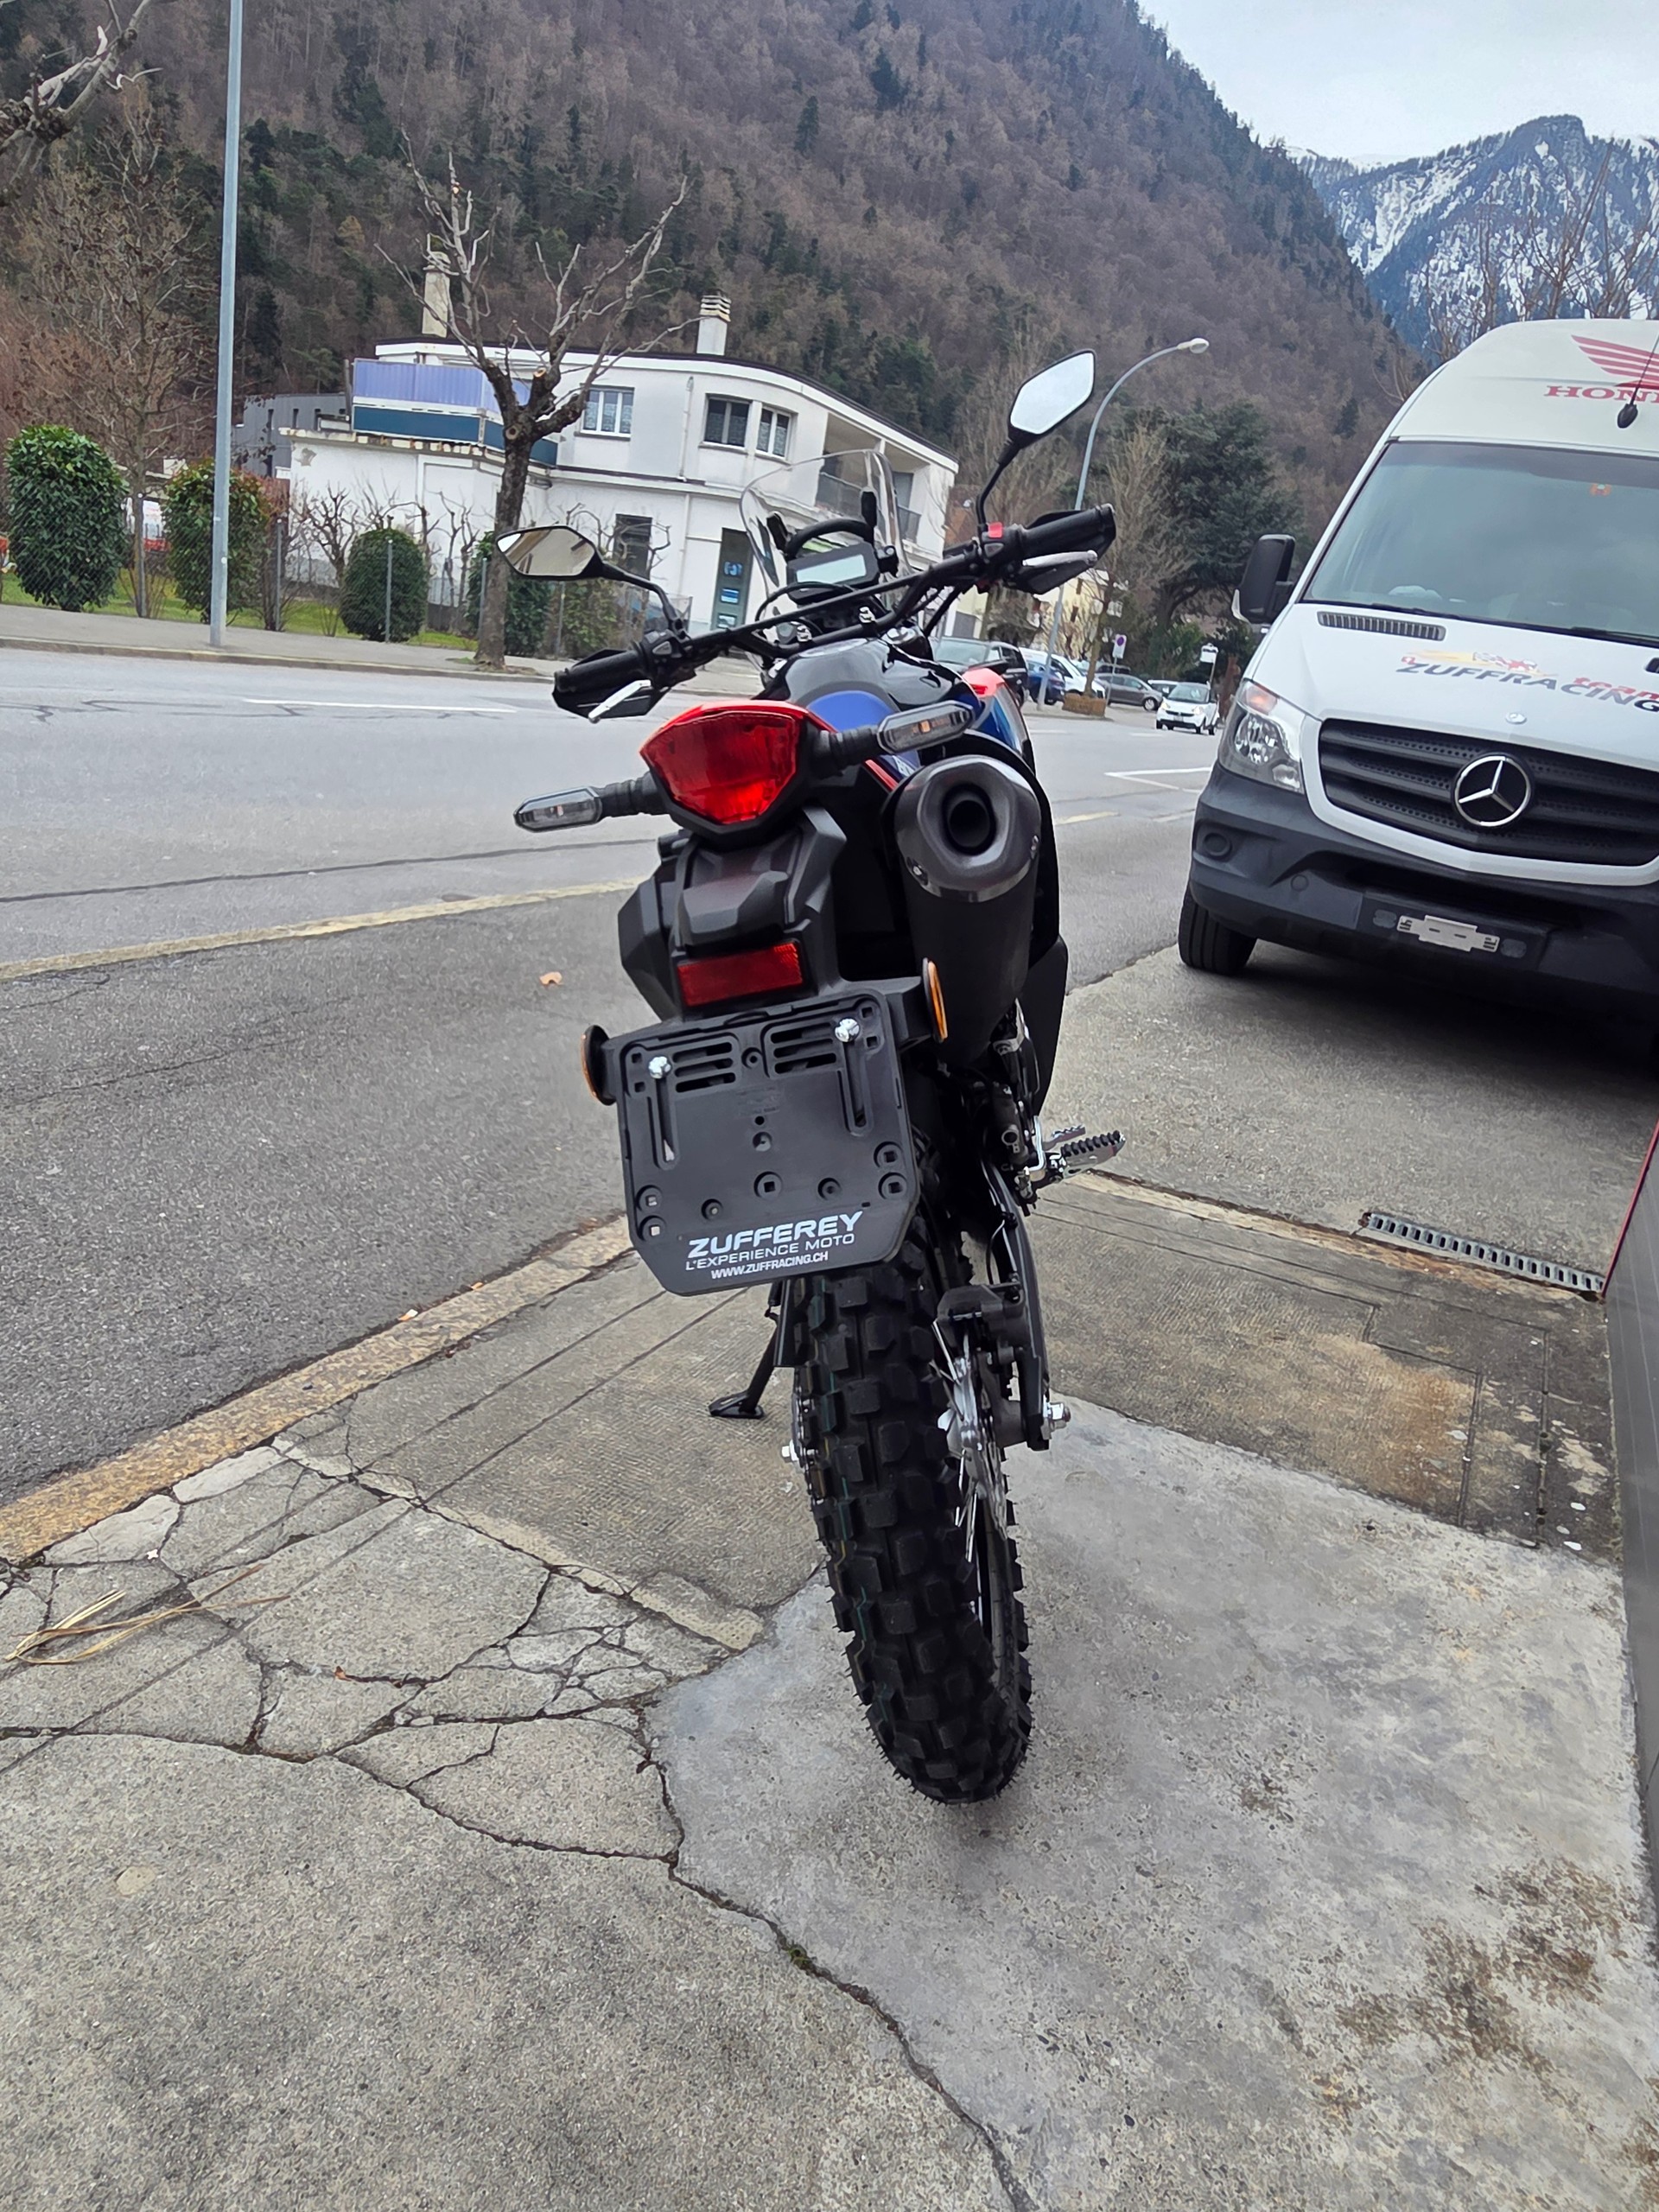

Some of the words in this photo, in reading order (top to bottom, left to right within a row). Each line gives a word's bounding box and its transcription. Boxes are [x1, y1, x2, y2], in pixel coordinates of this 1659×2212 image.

[1543, 385, 1659, 404] HON
[1395, 663, 1659, 712] ZUFFRACING
[685, 1243, 799, 1271] L'EXPERIENCE
[804, 1233, 855, 1251] MOTO
[688, 1211, 863, 1259] ZUFFEREY
[711, 1250, 829, 1279] WWW.ZUFFRACING.CH
